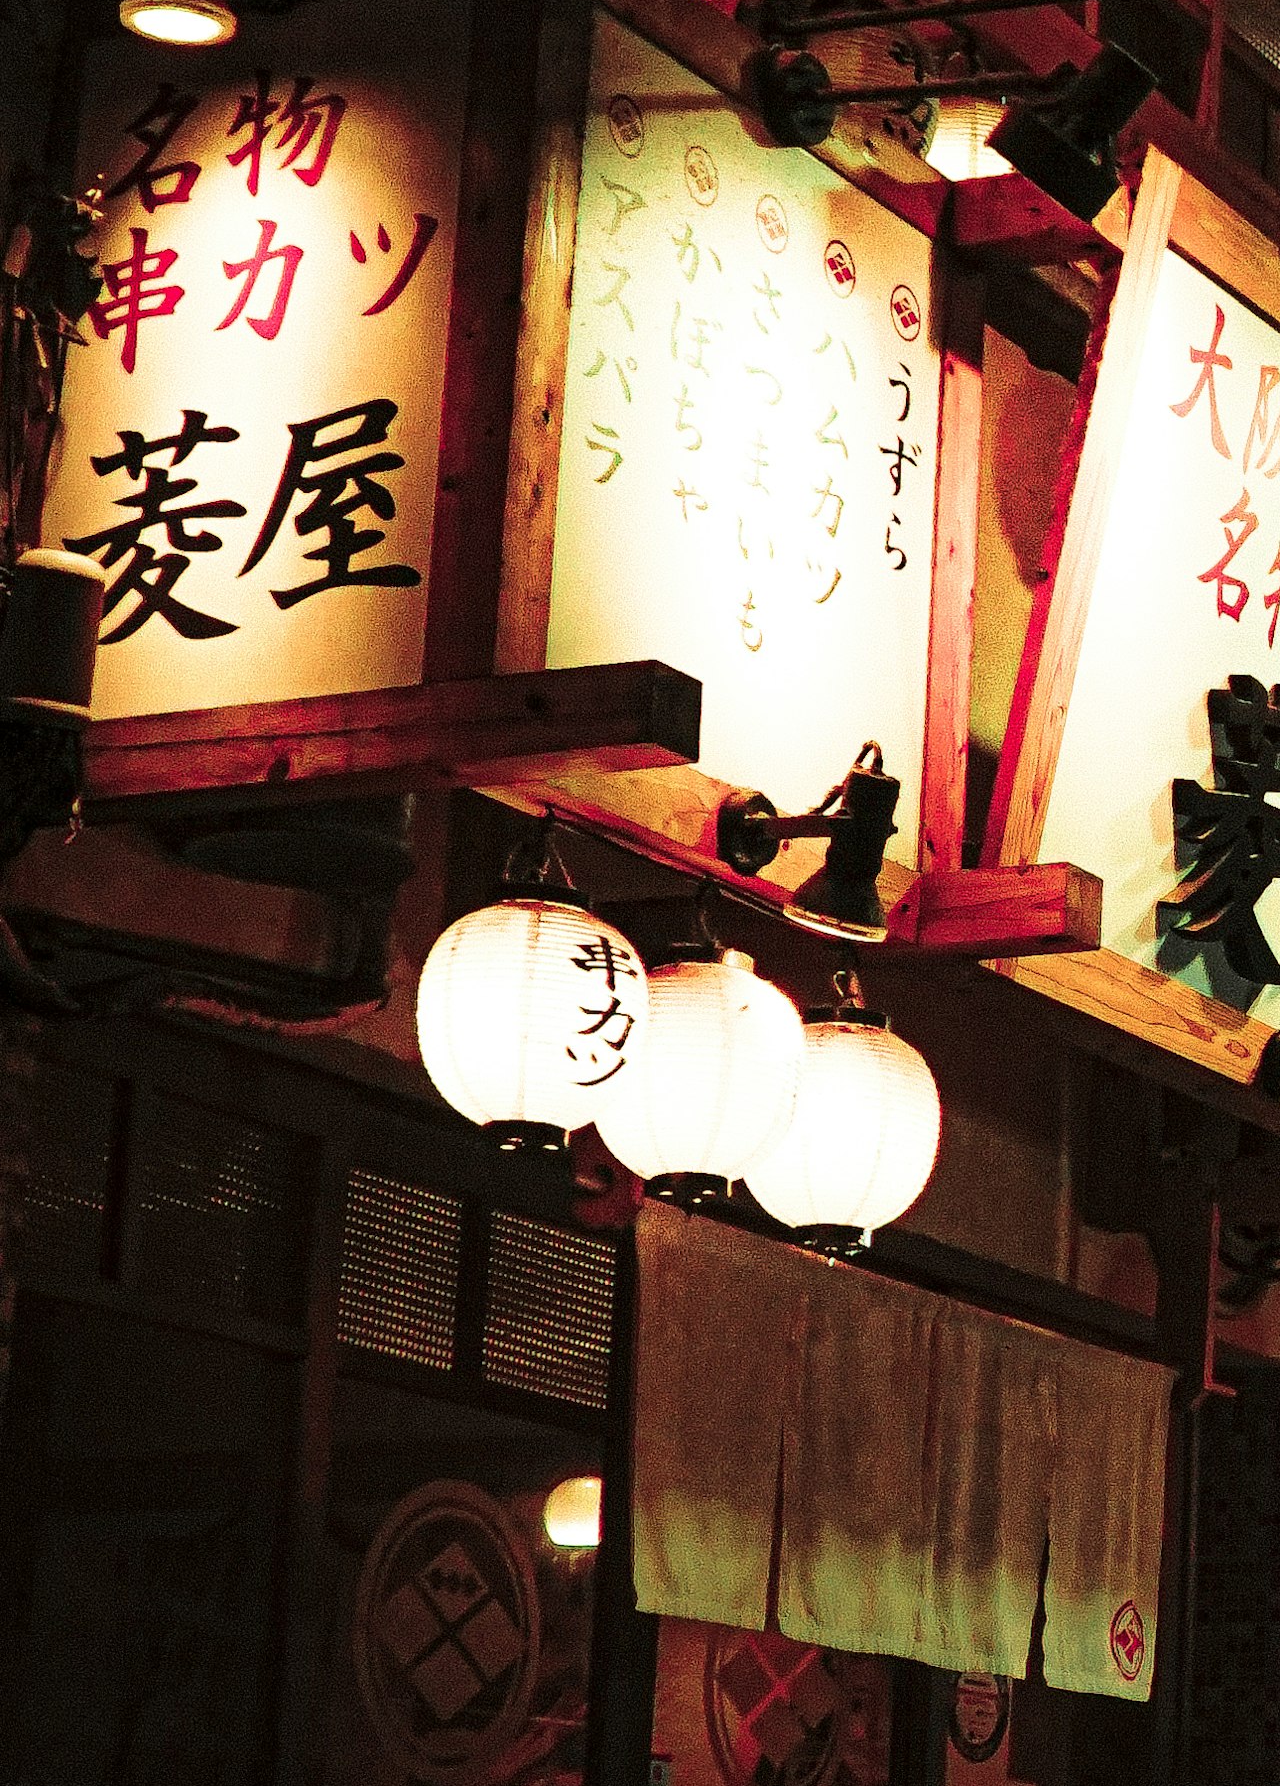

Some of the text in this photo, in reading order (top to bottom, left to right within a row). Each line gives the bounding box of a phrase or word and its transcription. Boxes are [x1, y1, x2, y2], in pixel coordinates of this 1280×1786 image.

[101, 70, 347, 214] 名物
[87, 213, 438, 374] 串カツ
[62, 396, 422, 646] 菱屋
[805, 331, 857, 604] ハムカツ
[878, 360, 923, 572] うずら
[569, 934, 638, 1087] 串カツ
